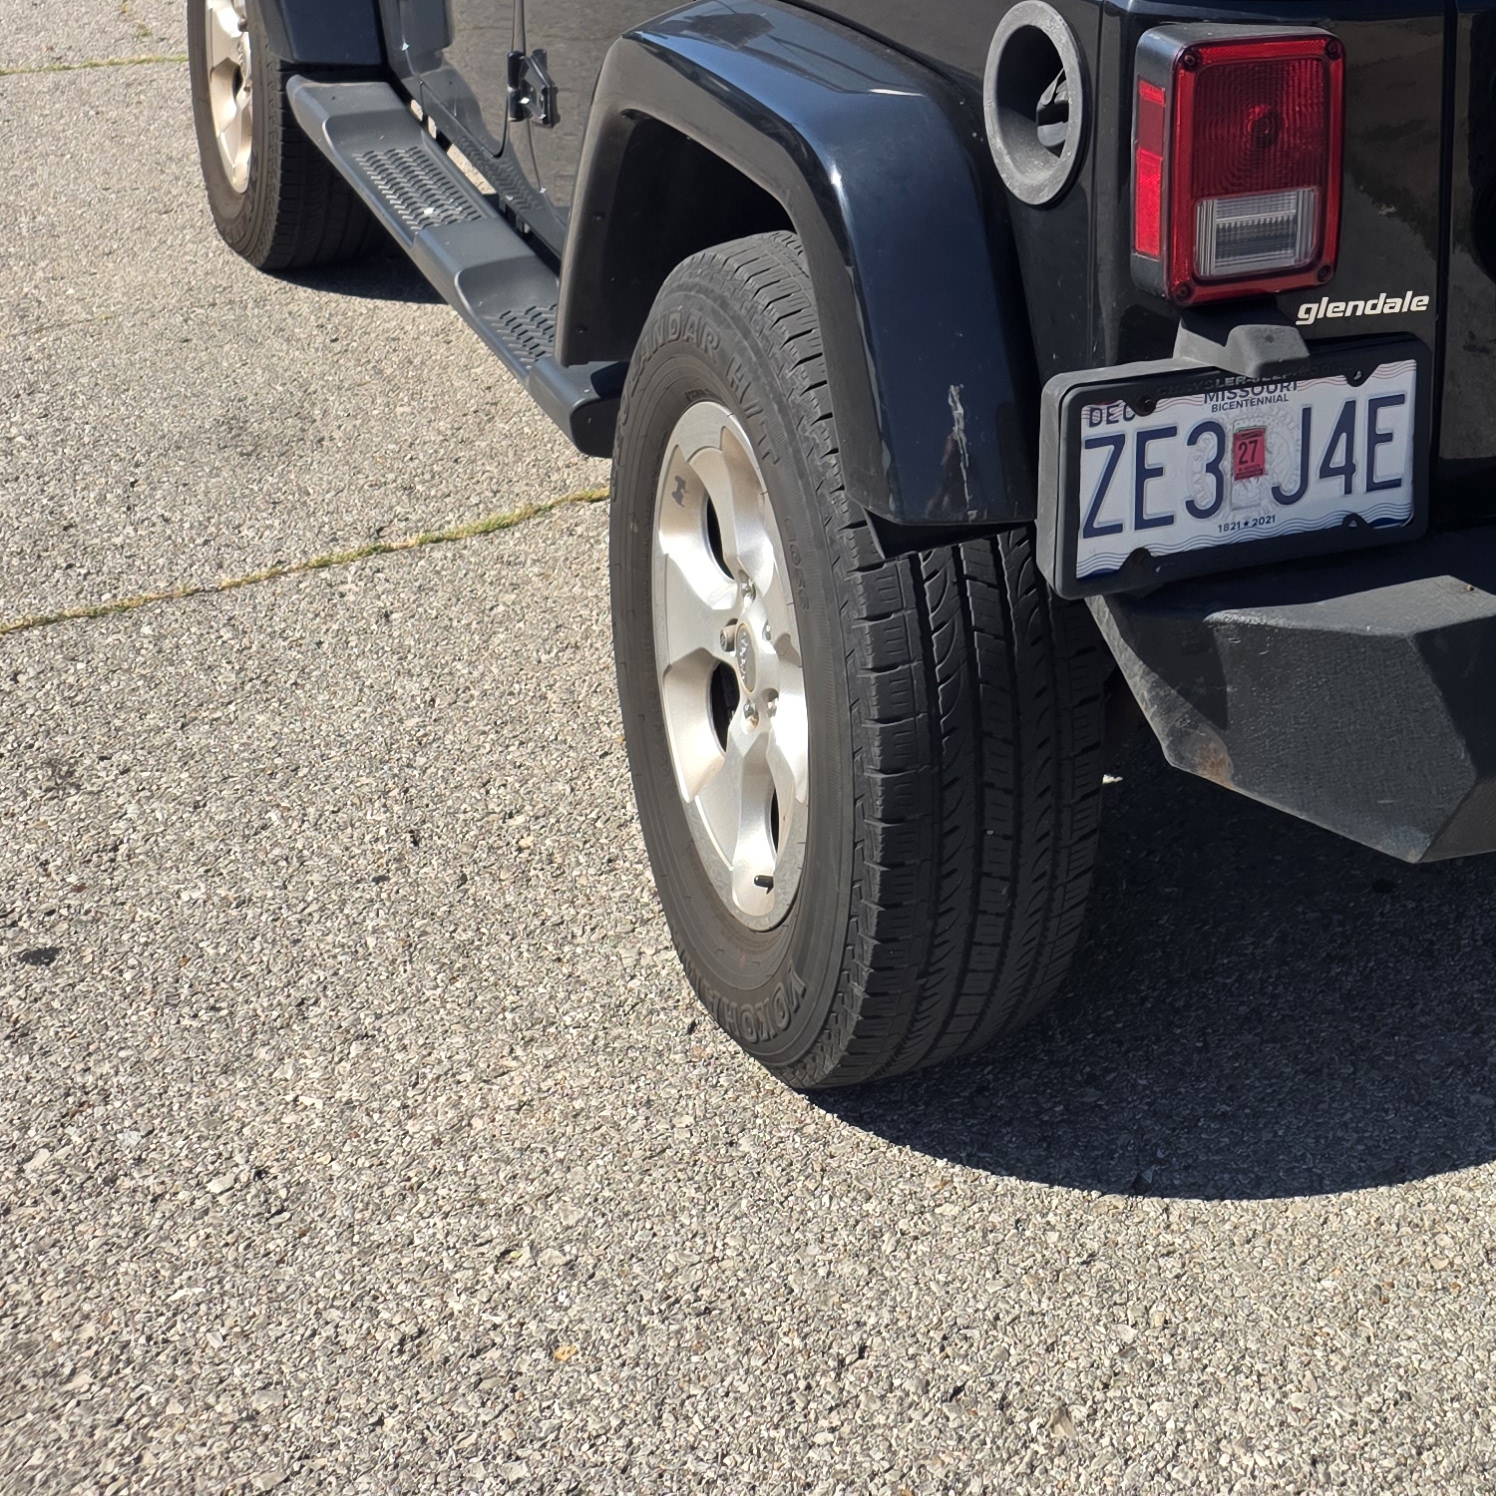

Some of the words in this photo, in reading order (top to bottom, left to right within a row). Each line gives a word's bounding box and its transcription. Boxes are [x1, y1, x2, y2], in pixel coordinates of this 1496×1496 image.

[1296, 290, 1430, 325] glendale
[1204, 381, 1298, 405] MISSOURI
[1211, 393, 1290, 413] BICENTENNIAL
[1089, 404, 1136, 429] DEC
[1238, 439, 1259, 466] 27
[1082, 420, 1226, 539] ZE3
[1271, 393, 1406, 505] J4E
[1218, 521, 1242, 533] 1821
[1252, 515, 1276, 528] 2021
